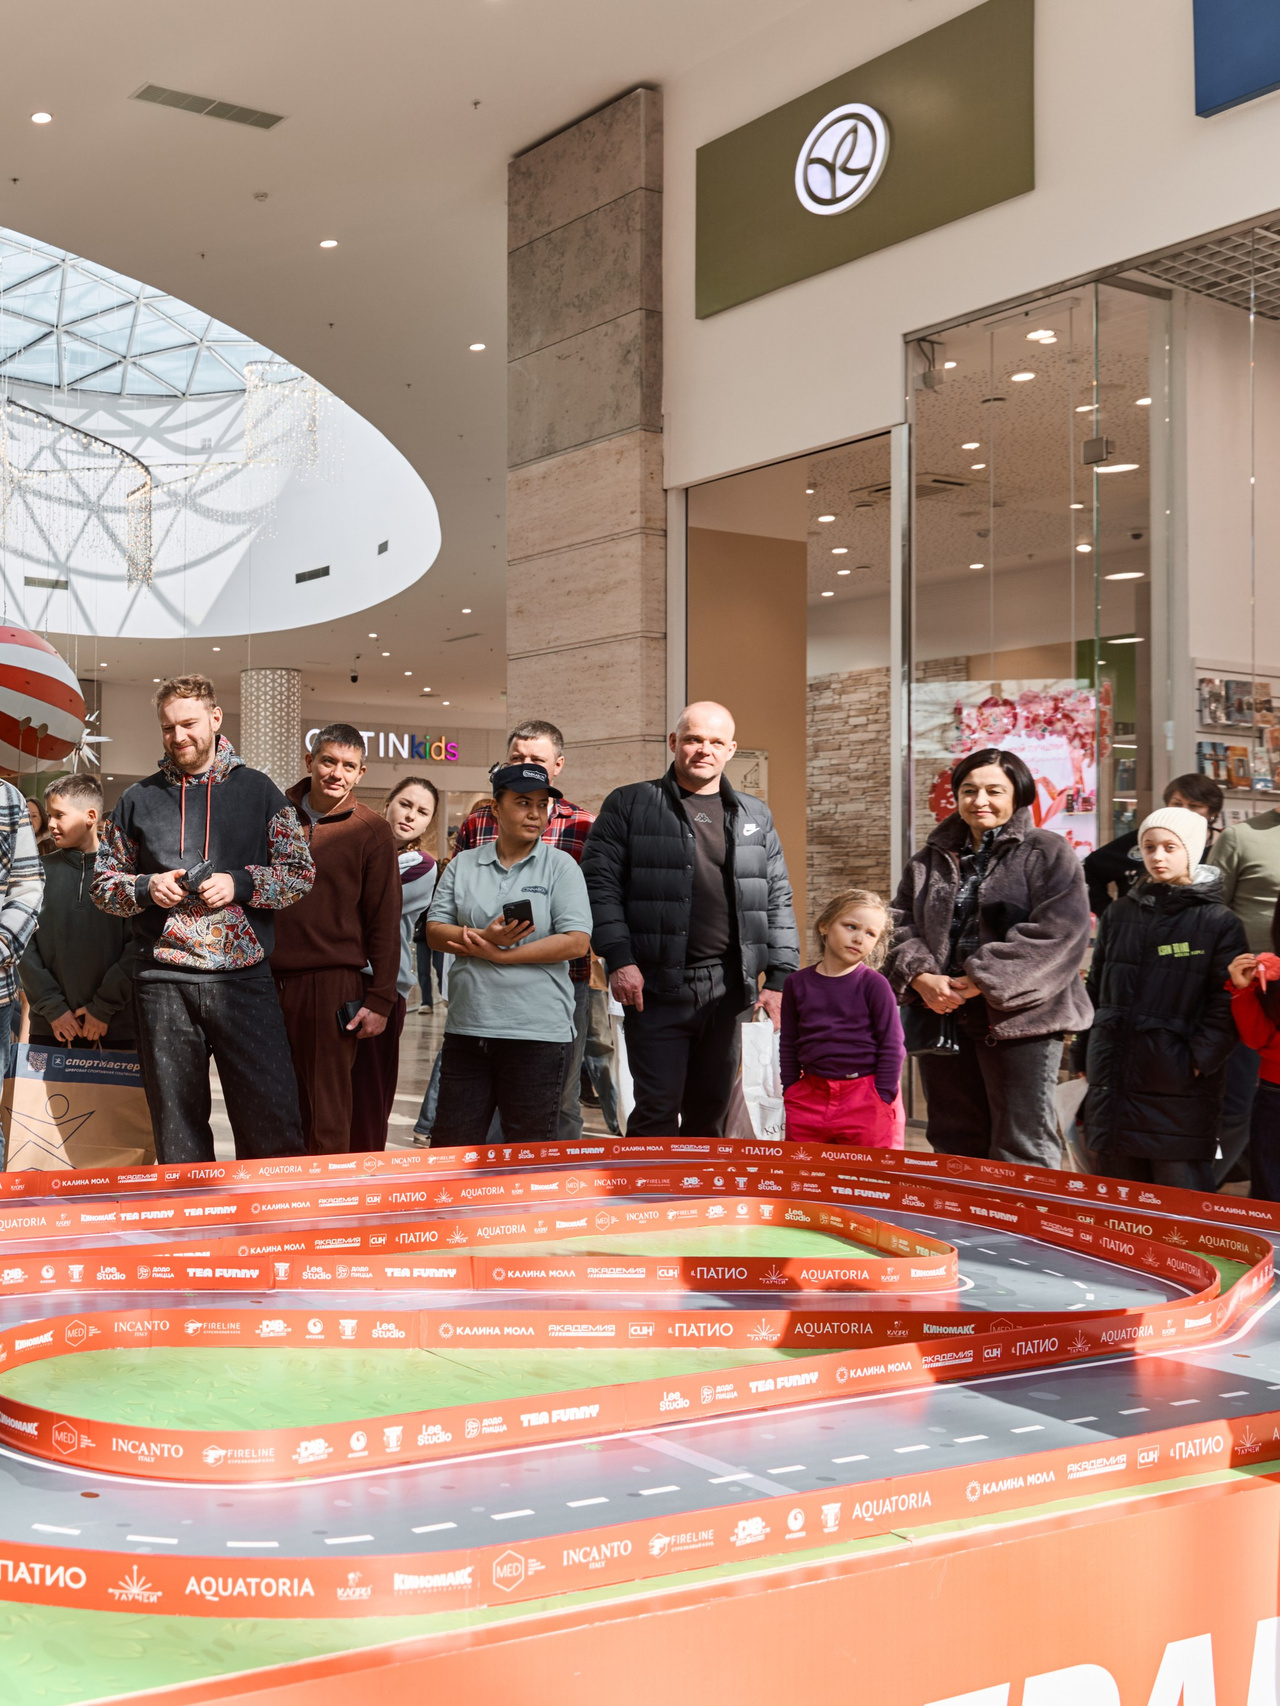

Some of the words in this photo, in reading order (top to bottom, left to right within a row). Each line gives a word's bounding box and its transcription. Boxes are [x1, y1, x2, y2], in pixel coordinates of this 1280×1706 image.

[411, 735, 460, 761] kids
[745, 1147, 782, 1156] ПАТИО
[821, 1151, 872, 1162] AQUATORIA
[191, 1169, 226, 1179] ПАТИО
[259, 1165, 302, 1176] AQUATORIA
[981, 1165, 1015, 1178] INCANTO
[594, 1178, 627, 1187] INCANTO
[758, 1183, 782, 1191] Studio
[392, 1192, 427, 1203] ПАТИО
[461, 1186, 504, 1198] AQUATORIA
[831, 1186, 853, 1196] TEA
[854, 1188, 890, 1199] FUNNY
[627, 1211, 659, 1221] INCANTO
[785, 1213, 810, 1223] Studio
[400, 1231, 438, 1244] ПАТИО
[477, 1224, 526, 1239] AQUATORIA
[250, 1244, 282, 1254] КАЛИНА
[284, 1243, 306, 1251] МОЛЛ
[1103, 1237, 1135, 1256] ПАТИО
[1199, 1234, 1250, 1254] AQUATORIA
[187, 1268, 212, 1278] TEA
[215, 1268, 259, 1279] FUNNY
[306, 1265, 323, 1273] Lee
[385, 1268, 411, 1278] TEA
[413, 1268, 457, 1278] FUNNY
[697, 1267, 747, 1280] ПАТИО
[1166, 1257, 1201, 1278] AQUATORIA
[96, 1271, 126, 1281] Studio
[302, 1271, 332, 1280] Studio
[549, 1270, 576, 1278] МОЛЛ
[800, 1269, 870, 1282] AQUATORIA
[115, 1320, 170, 1332] INCANTO
[203, 1322, 241, 1330] FIRELINE
[377, 1321, 395, 1330] Lee
[457, 1327, 501, 1335] КАЛИНА
[504, 1327, 534, 1335] МОЛЛ
[675, 1323, 733, 1337] ПАТИО
[795, 1322, 873, 1337] AQUATORIA
[923, 1323, 975, 1335] КИНОМАКС
[67, 1328, 84, 1337] MED
[372, 1328, 405, 1339] Studio
[1100, 1325, 1154, 1345] AQUATORIA
[15, 1330, 55, 1350] КИНОМАКС
[1016, 1337, 1058, 1356] ПАТИО
[850, 1364, 886, 1378] КАЛИНА
[887, 1361, 912, 1373] МОЛЛ
[749, 1379, 775, 1393] TEA
[776, 1372, 818, 1390] FUNNY
[664, 1391, 681, 1400] Lee
[659, 1399, 690, 1412] Studio
[521, 1411, 549, 1427] TEA
[551, 1404, 600, 1424] FUNNY
[483, 1417, 502, 1427] ДОДО
[422, 1424, 442, 1434] Lee
[482, 1424, 507, 1434] ПИЦЦА
[55, 1430, 75, 1444] MED
[417, 1431, 452, 1446] Studio
[112, 1438, 183, 1458] INCANTO
[227, 1448, 275, 1458] FIRELINE
[1176, 1435, 1224, 1460] ПАТИО
[983, 1477, 1025, 1495] КАЛИНА
[1027, 1470, 1055, 1486] МОЛЛ
[852, 1491, 932, 1521] AQUATORIA
[671, 1529, 714, 1546] FIRELINE
[563, 1540, 632, 1566] INCANTO
[496, 1562, 521, 1579] MED
[589, 1561, 606, 1570] ITALY
[394, 1566, 473, 1590] КИНОМАКС
[185, 1576, 315, 1601] AQUATORIA
